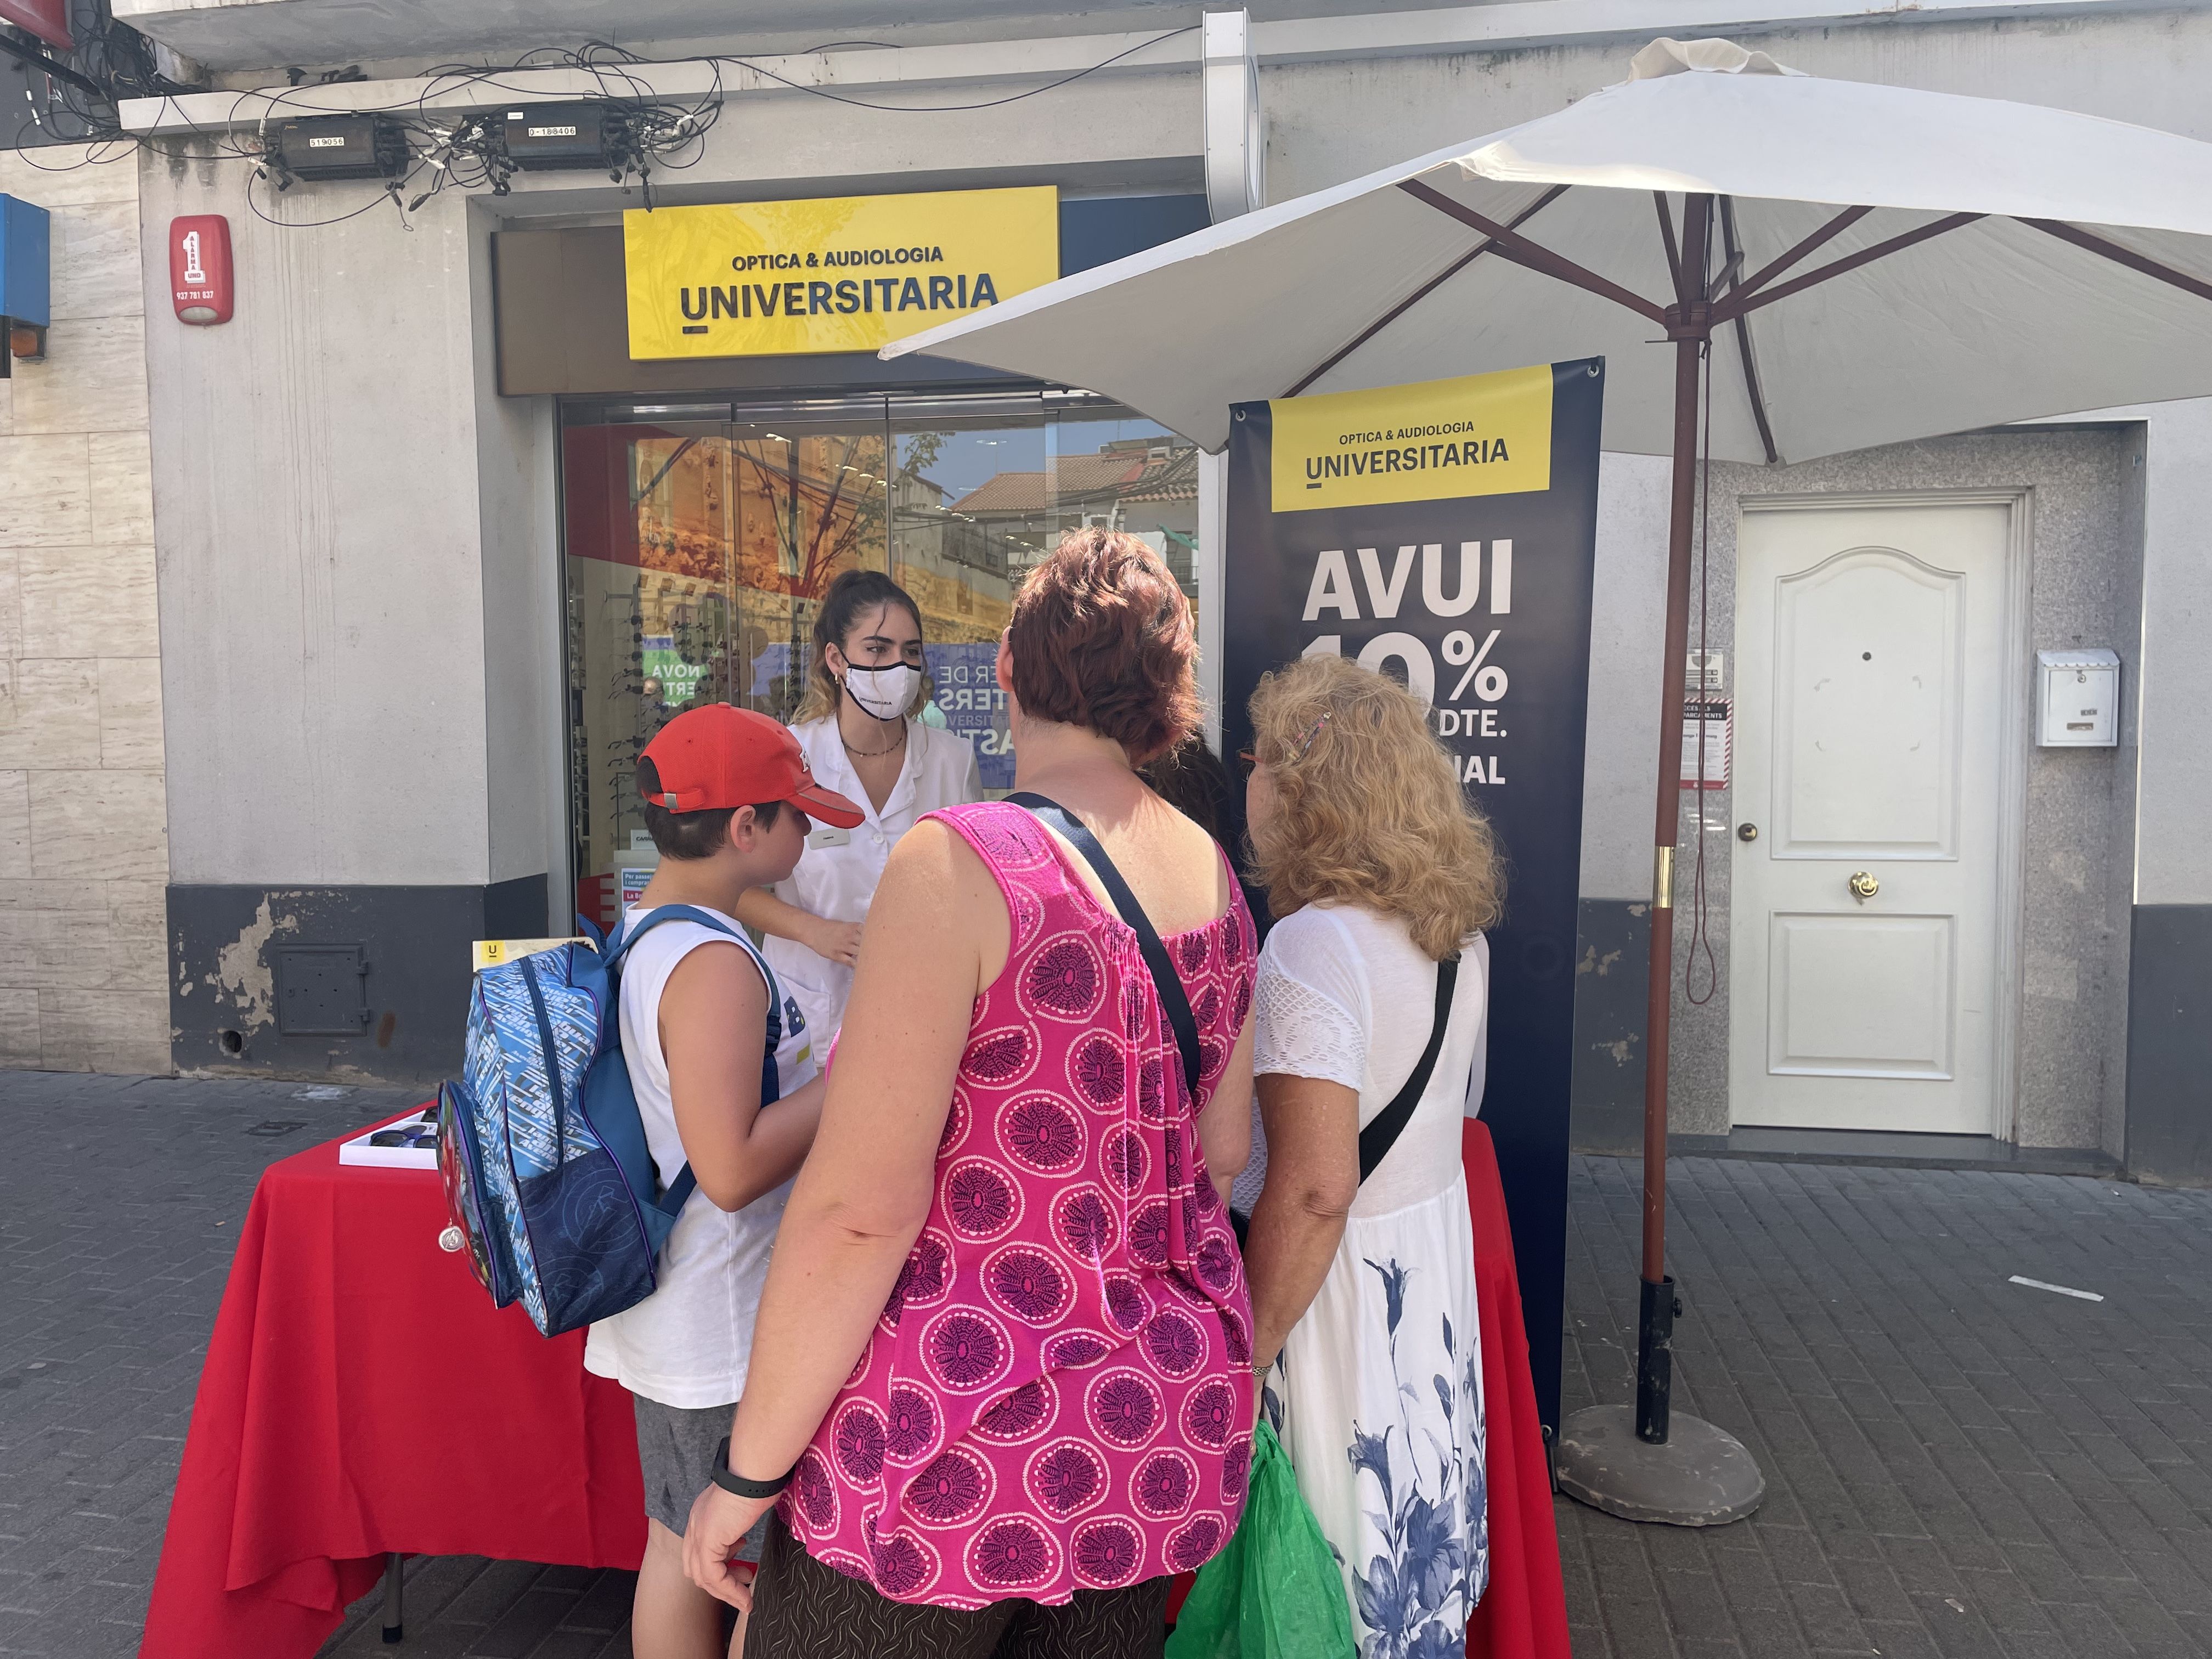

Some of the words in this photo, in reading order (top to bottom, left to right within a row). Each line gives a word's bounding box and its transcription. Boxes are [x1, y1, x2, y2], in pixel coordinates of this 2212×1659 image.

[311, 138, 343, 146] 519056
[732, 253, 801, 271] OPTICA
[805, 252, 819, 267] &
[824, 246, 944, 266] AUDIOLOGIA
[681, 273, 998, 320] UNIVERSITARIA
[1339, 432, 1383, 445] OPTICA
[1385, 430, 1393, 440] &
[1397, 421, 1474, 439] AUDIOLOGIA
[1306, 438, 1509, 481] UNIVERSITARIA
[1302, 539, 1512, 621] AVUI
[1439, 709, 1507, 737] DTE.
[489, 945, 496, 953] U
